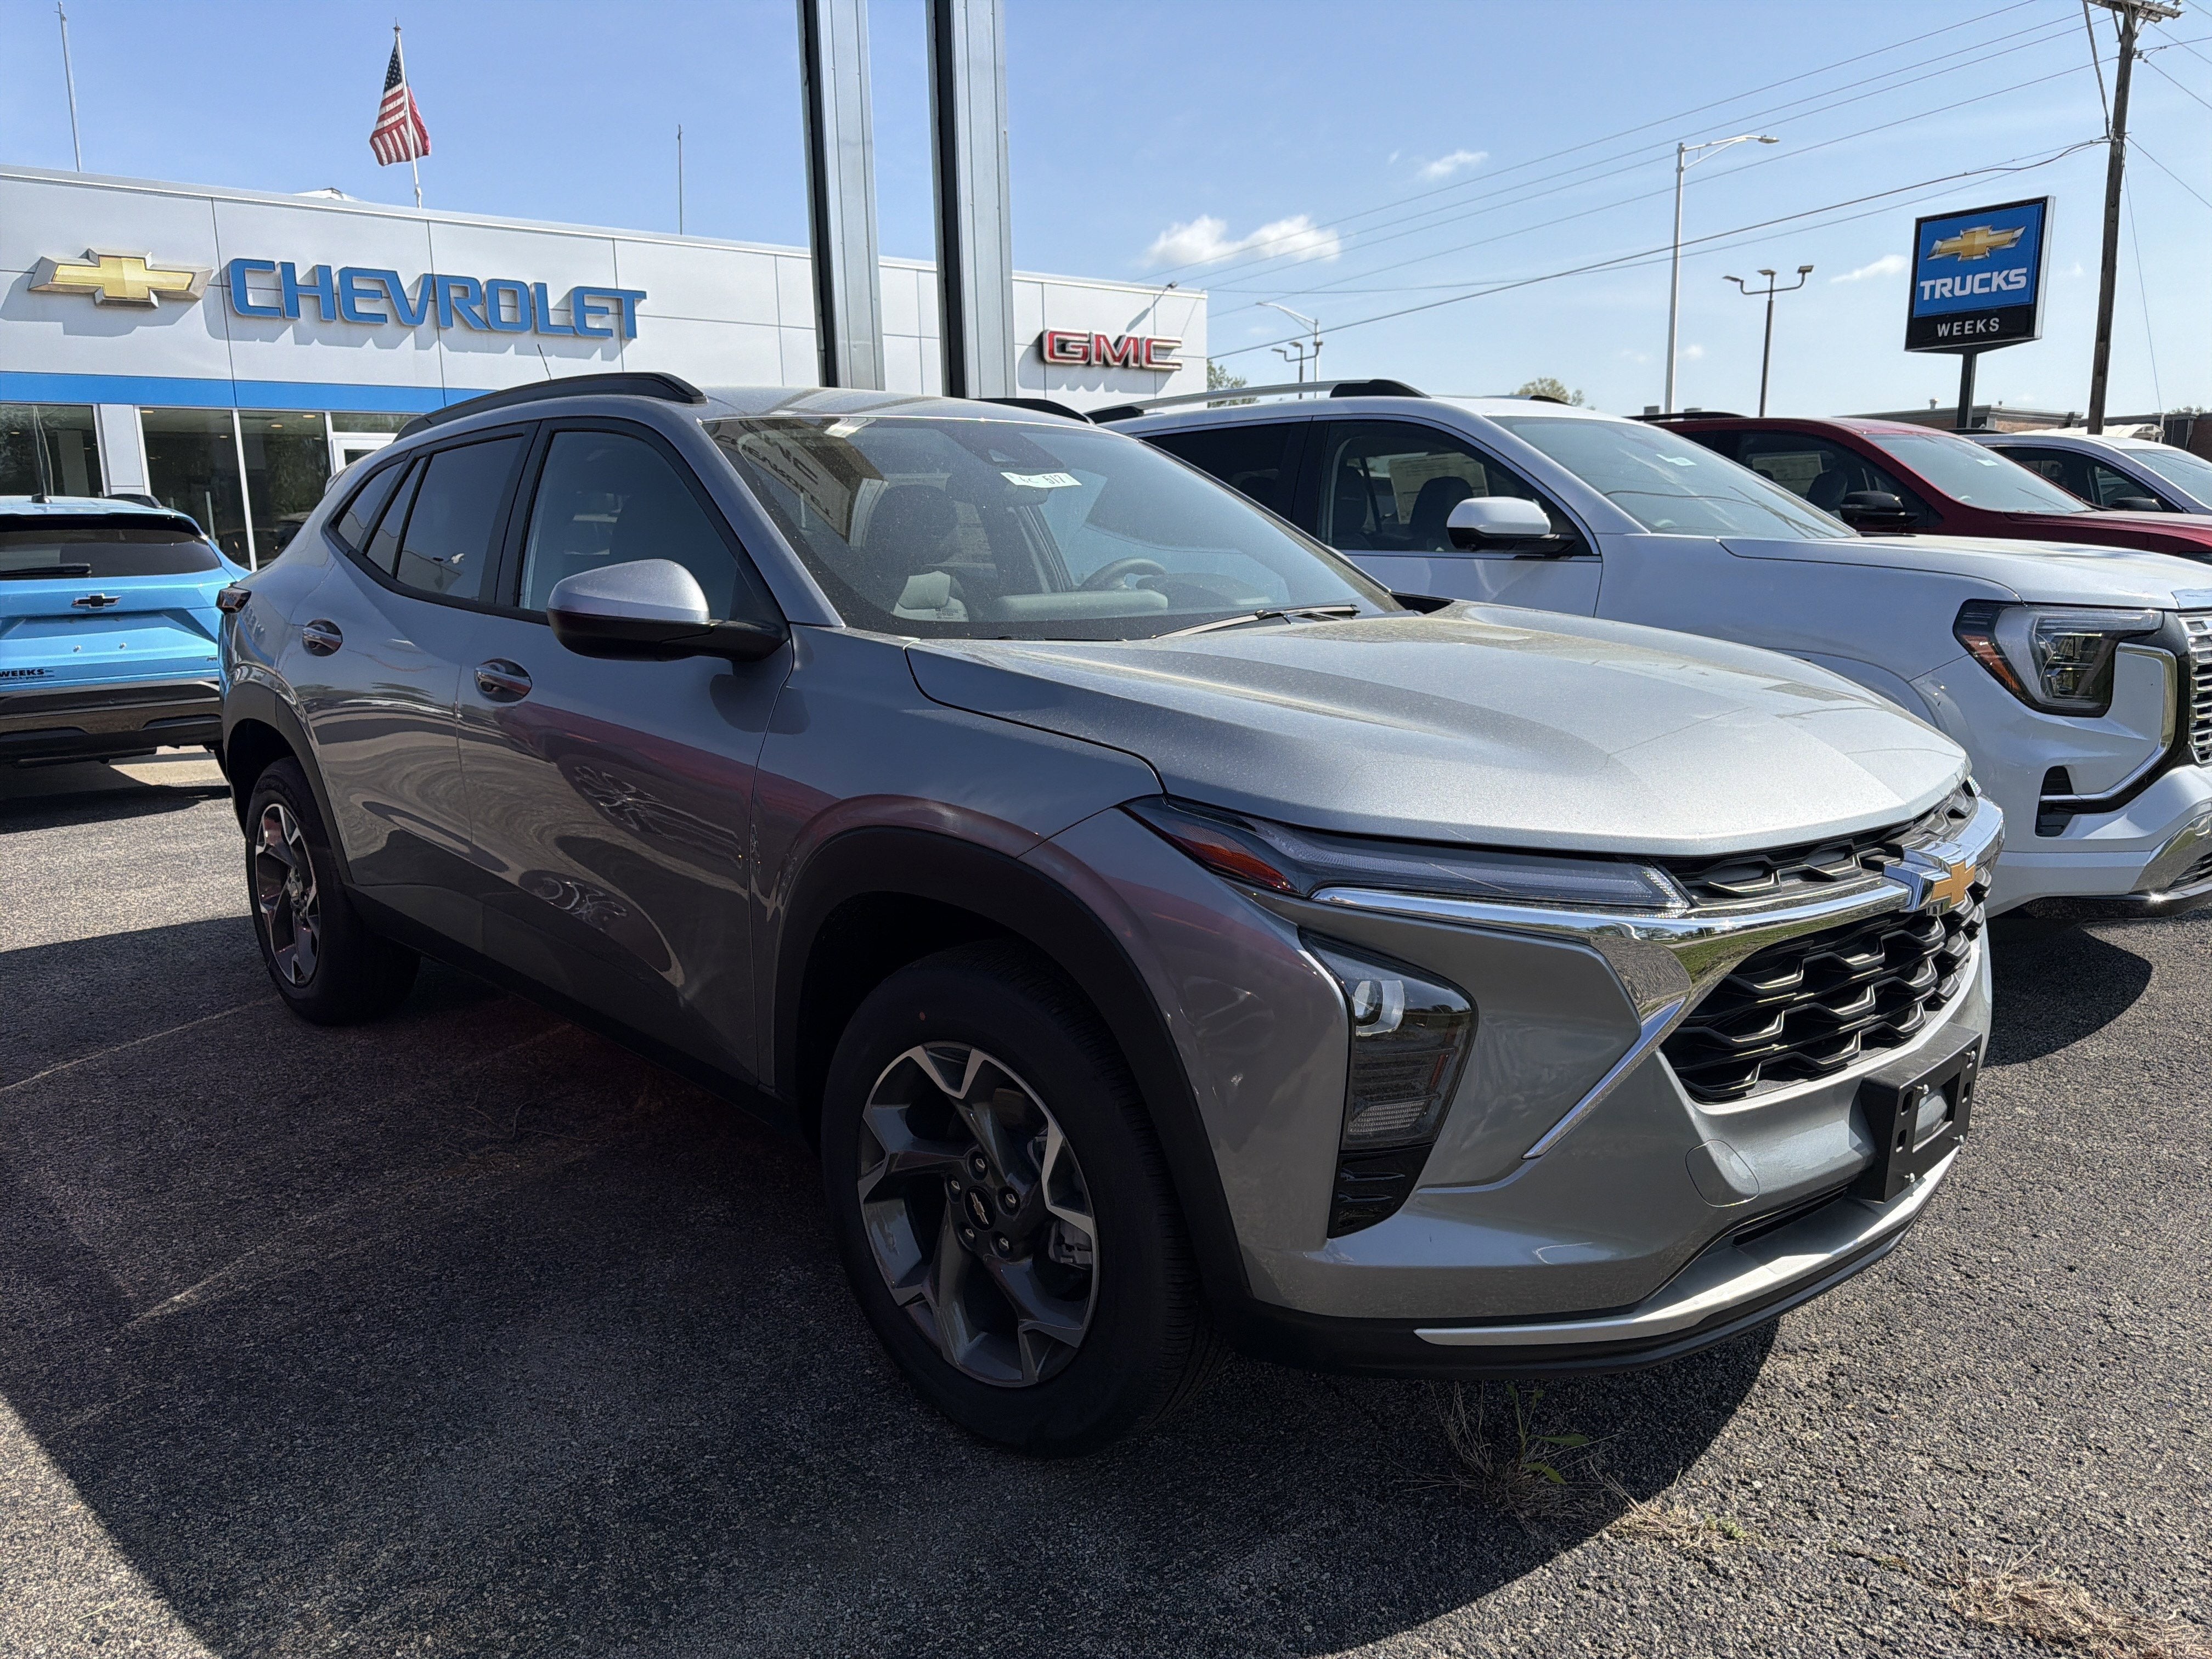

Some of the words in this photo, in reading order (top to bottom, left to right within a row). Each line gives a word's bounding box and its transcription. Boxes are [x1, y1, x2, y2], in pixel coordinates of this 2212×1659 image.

[1920, 268, 2027, 301] TRUCKS
[229, 258, 646, 340] CHEVROLET
[1937, 317, 2000, 337] WEEKS
[1044, 328, 1182, 370] GMC
[1042, 475, 1065, 484] 517
[0, 669, 44, 677] WEEKS
